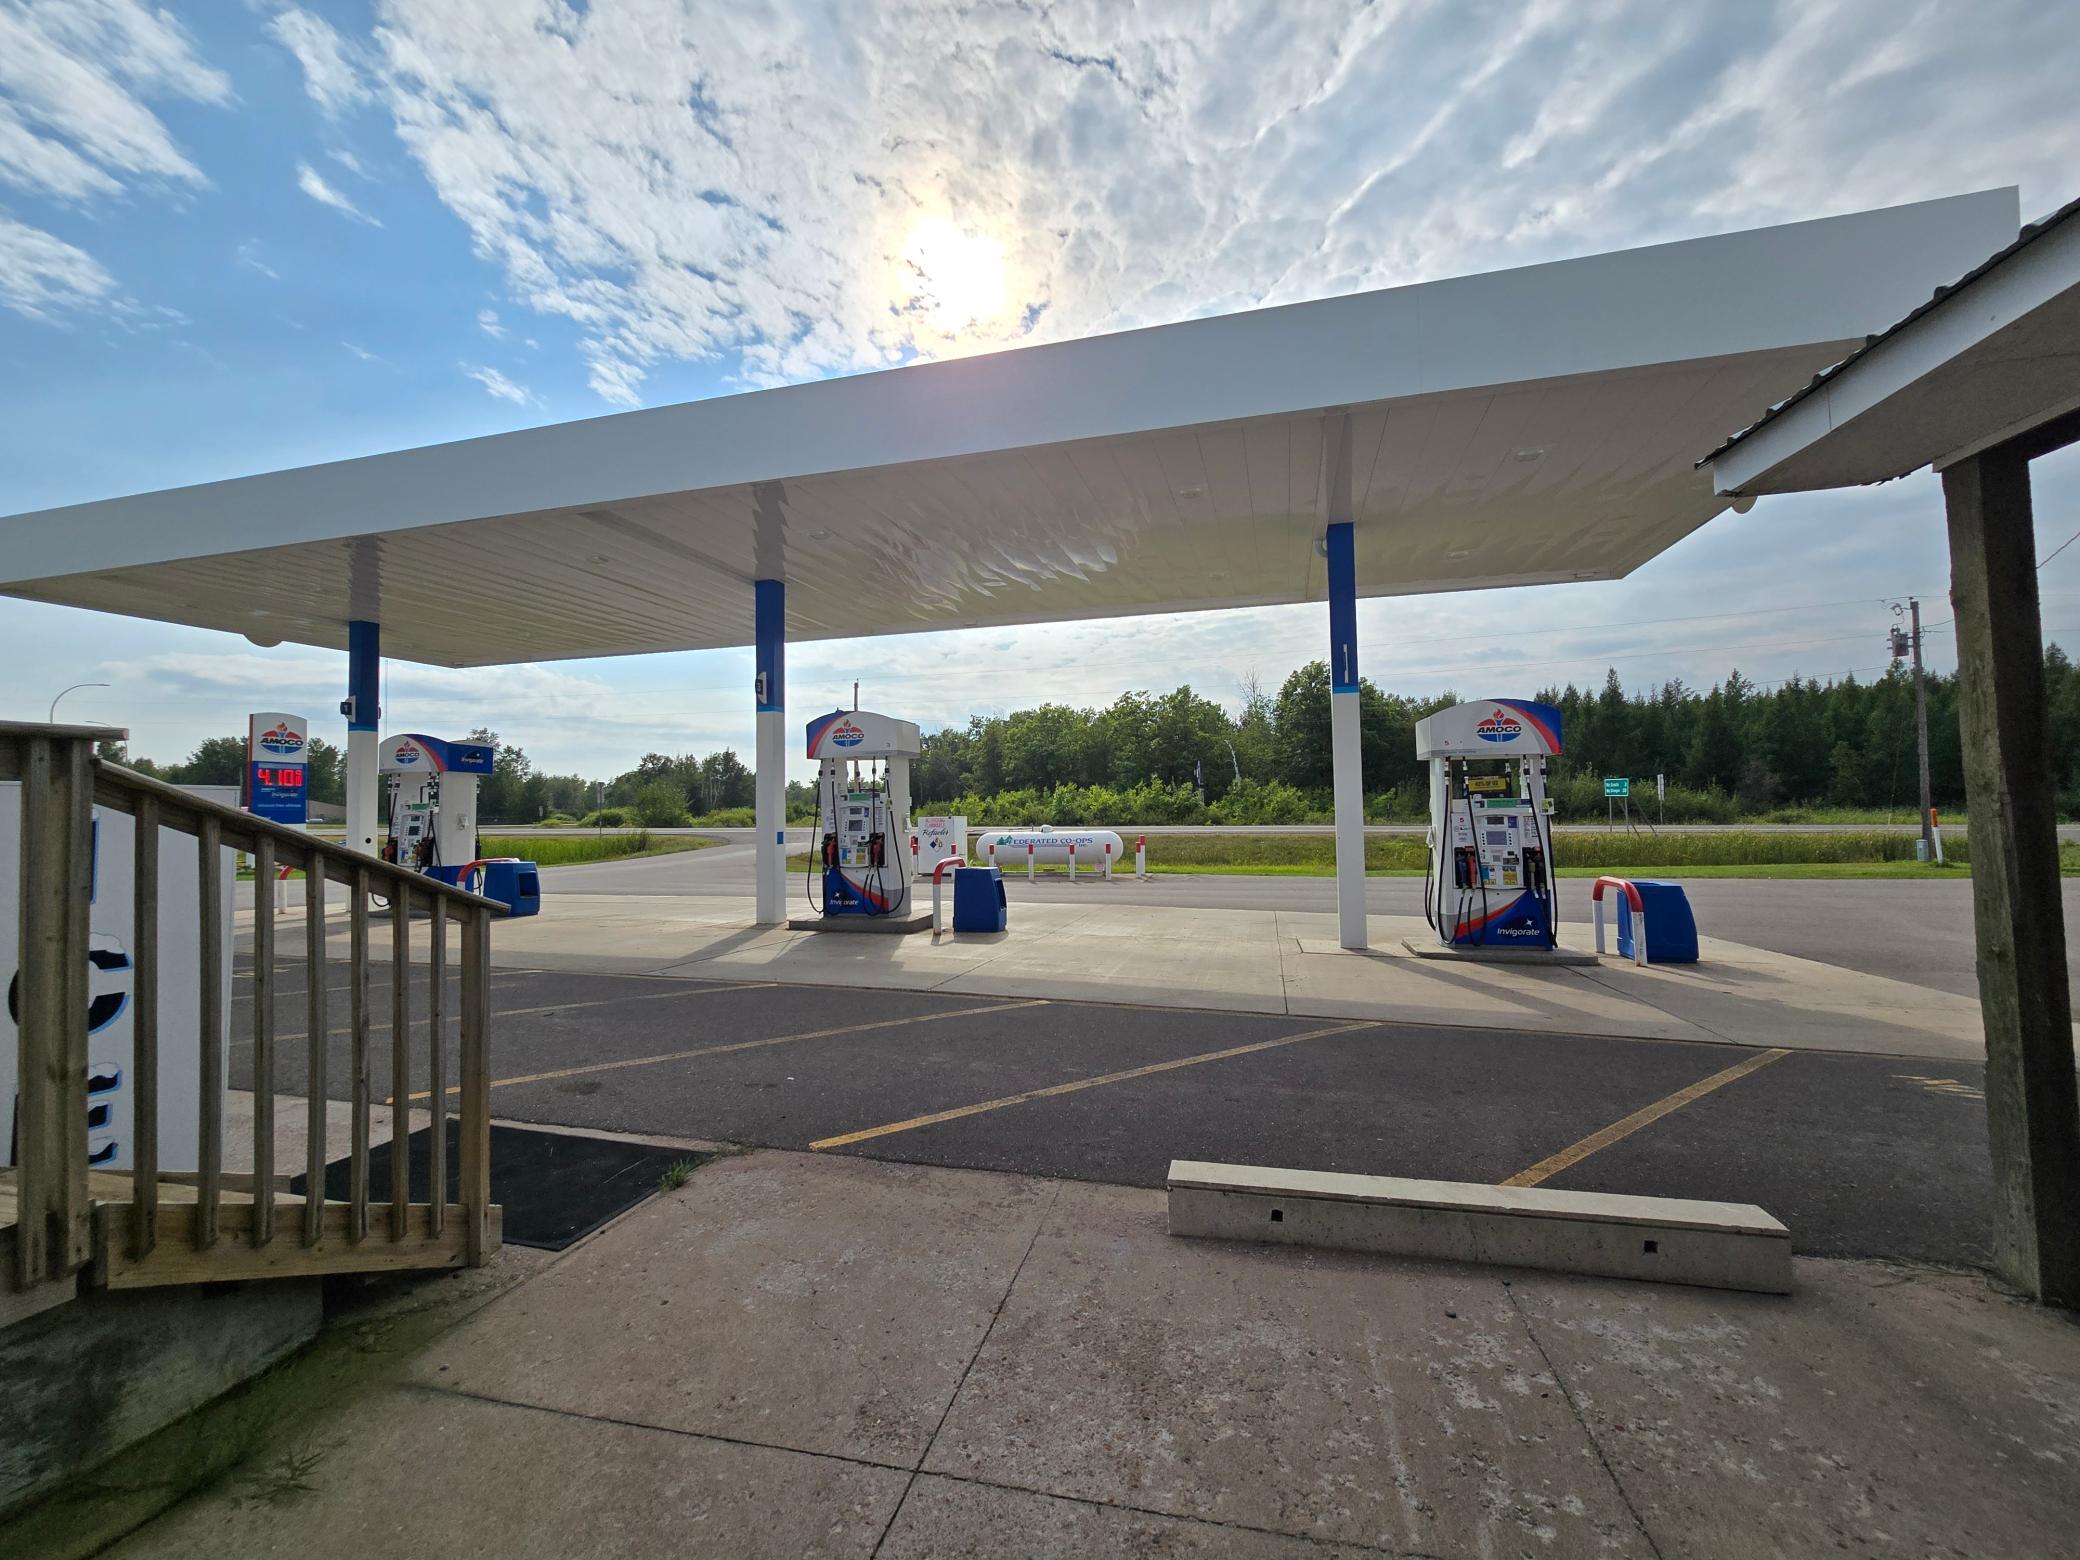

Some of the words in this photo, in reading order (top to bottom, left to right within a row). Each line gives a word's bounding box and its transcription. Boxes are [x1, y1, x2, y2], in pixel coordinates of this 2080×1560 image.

[1476, 725, 1521, 733] AMOCO
[260, 737, 303, 746] AMOCO
[1497, 926, 1540, 937] Invigorate
